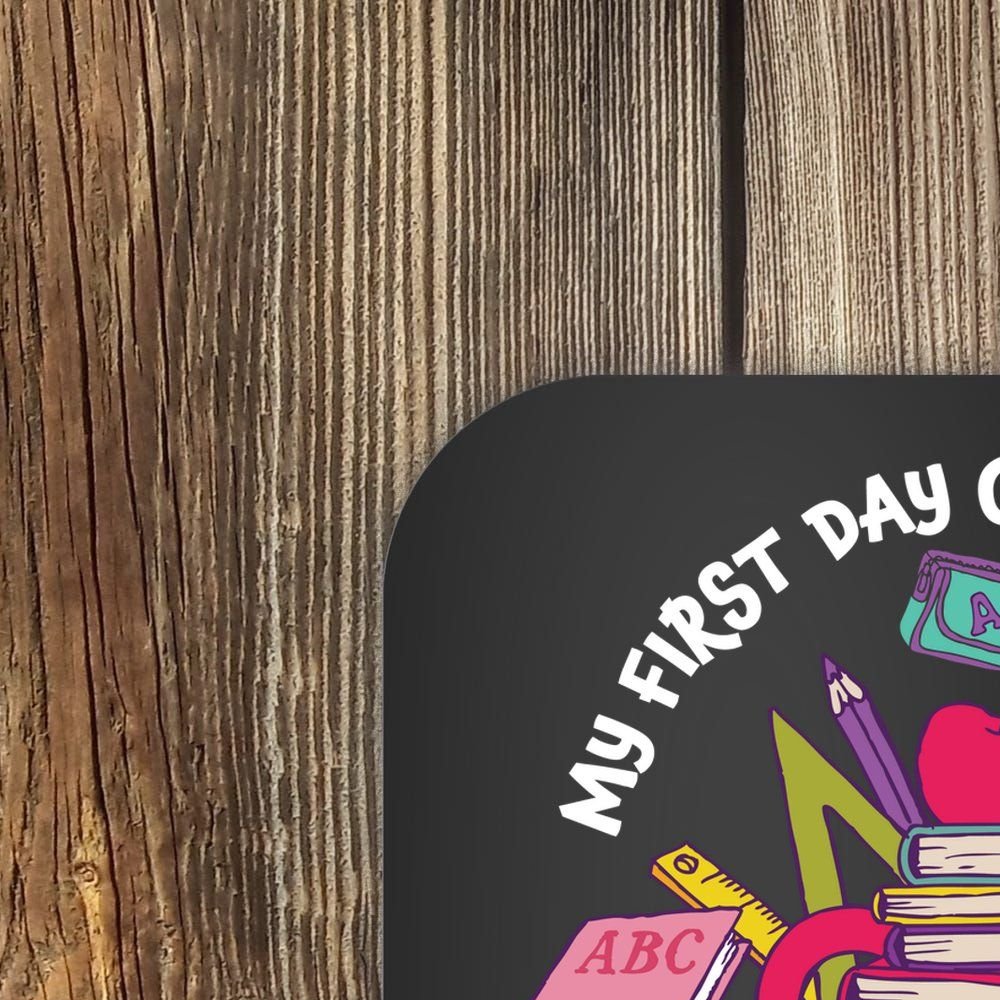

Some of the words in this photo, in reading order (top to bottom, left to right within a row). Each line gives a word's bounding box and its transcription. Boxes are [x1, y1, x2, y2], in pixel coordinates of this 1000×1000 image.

[559, 714, 656, 837] MY
[618, 527, 789, 710] FIRST
[801, 463, 950, 562] DAY
[574, 928, 705, 975] ABC
